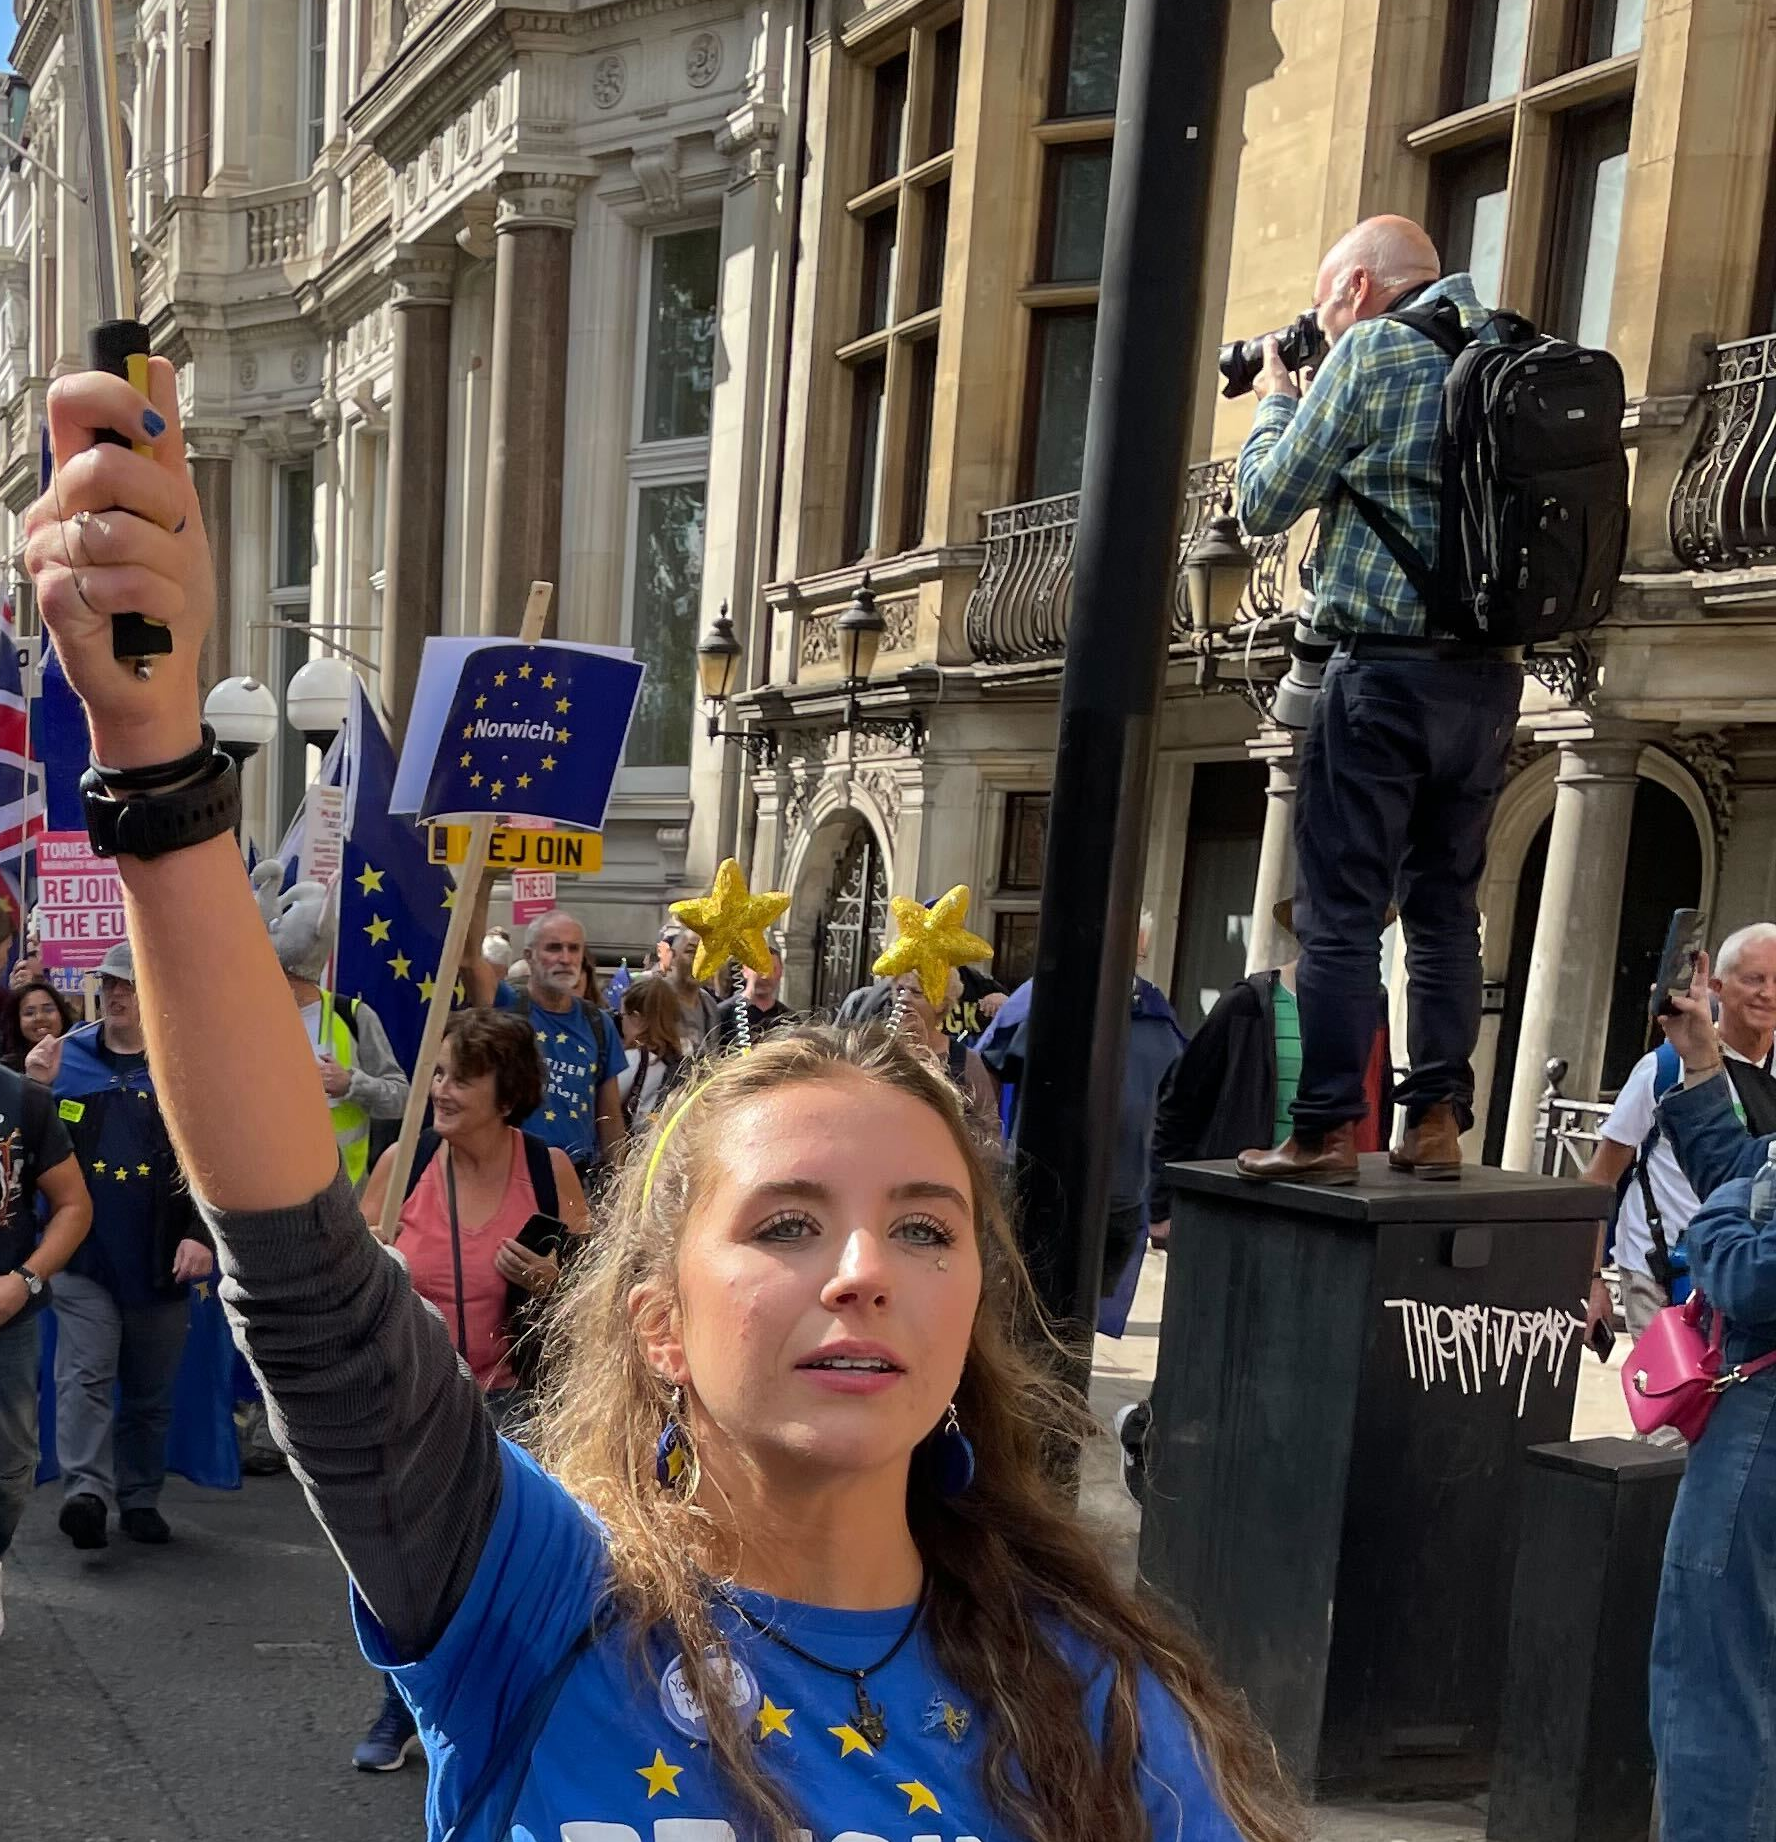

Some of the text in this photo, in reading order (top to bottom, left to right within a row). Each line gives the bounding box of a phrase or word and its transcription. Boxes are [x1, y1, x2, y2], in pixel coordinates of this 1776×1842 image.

[474, 718, 554, 741] Norwich
[43, 879, 122, 904] REJOIN
[515, 877, 554, 897] THE EU
[45, 912, 125, 938] THE EU
